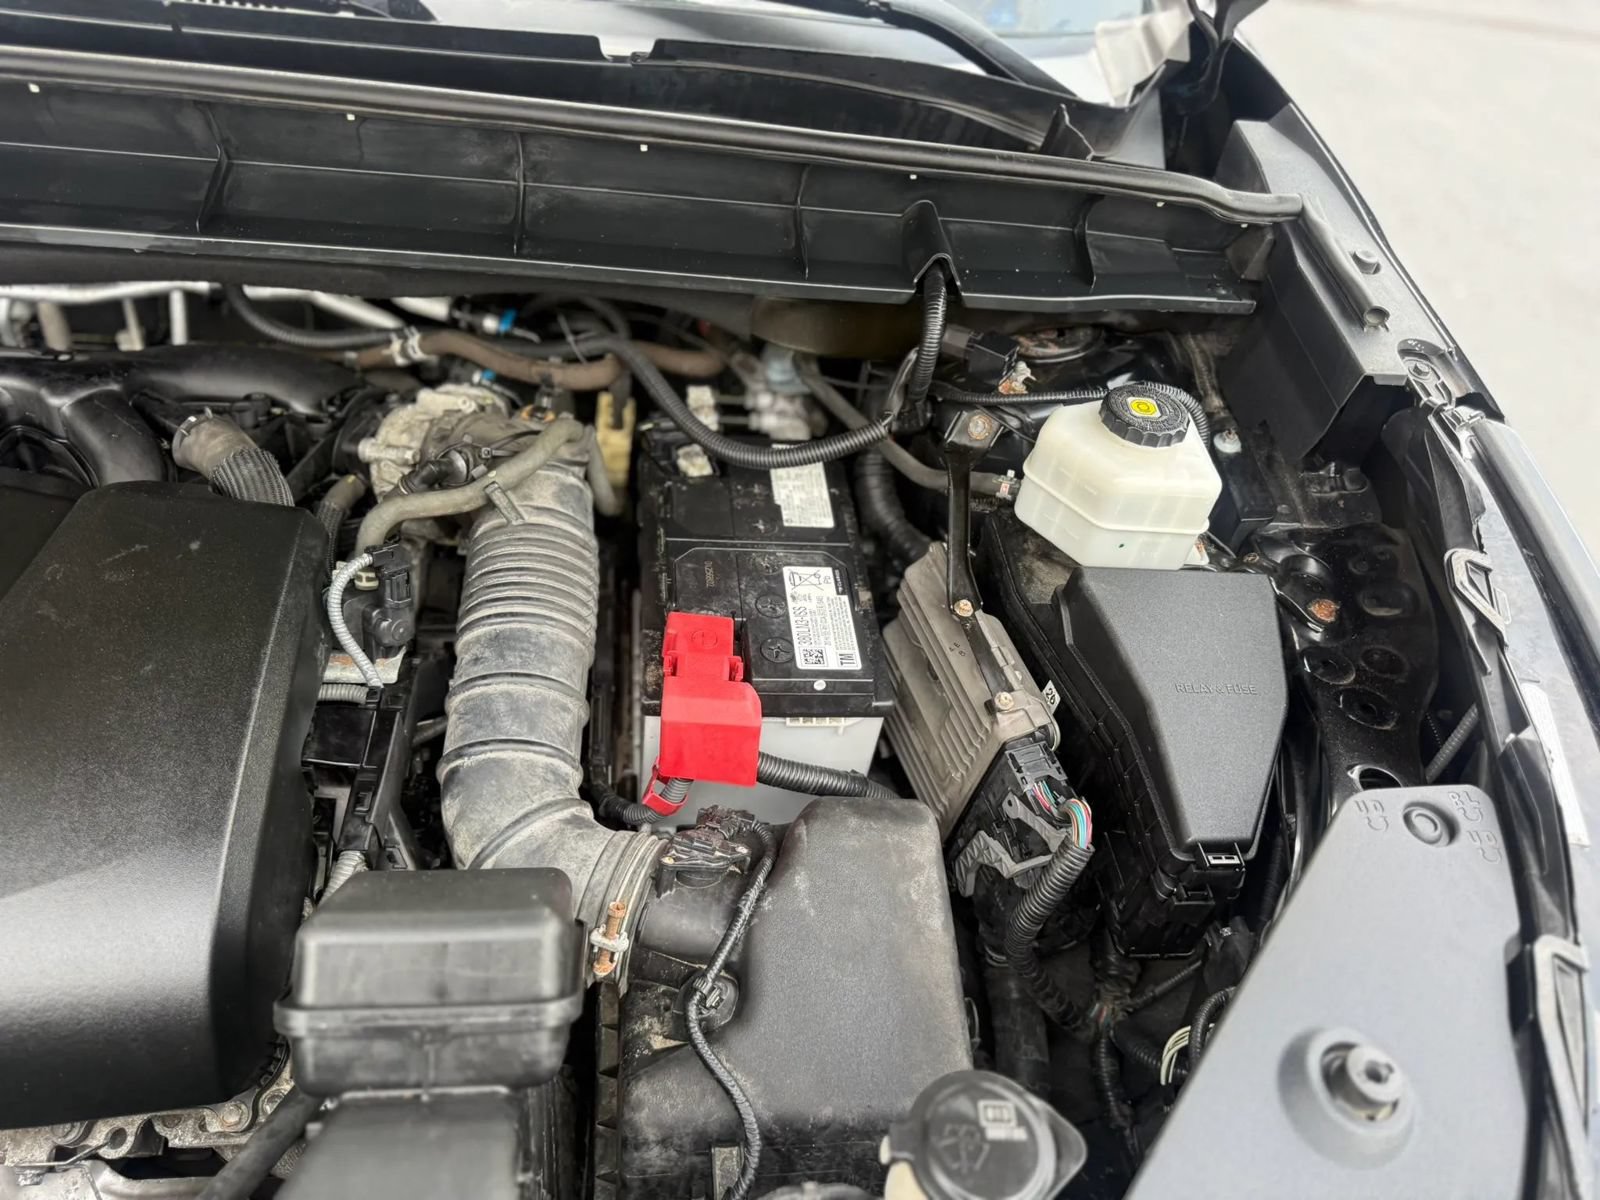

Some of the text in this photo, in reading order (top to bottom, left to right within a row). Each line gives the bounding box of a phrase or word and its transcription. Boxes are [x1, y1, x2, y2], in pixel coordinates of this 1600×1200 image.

[839, 653, 855, 666] TM
[1174, 683, 1258, 696] RELAY & FUSE
